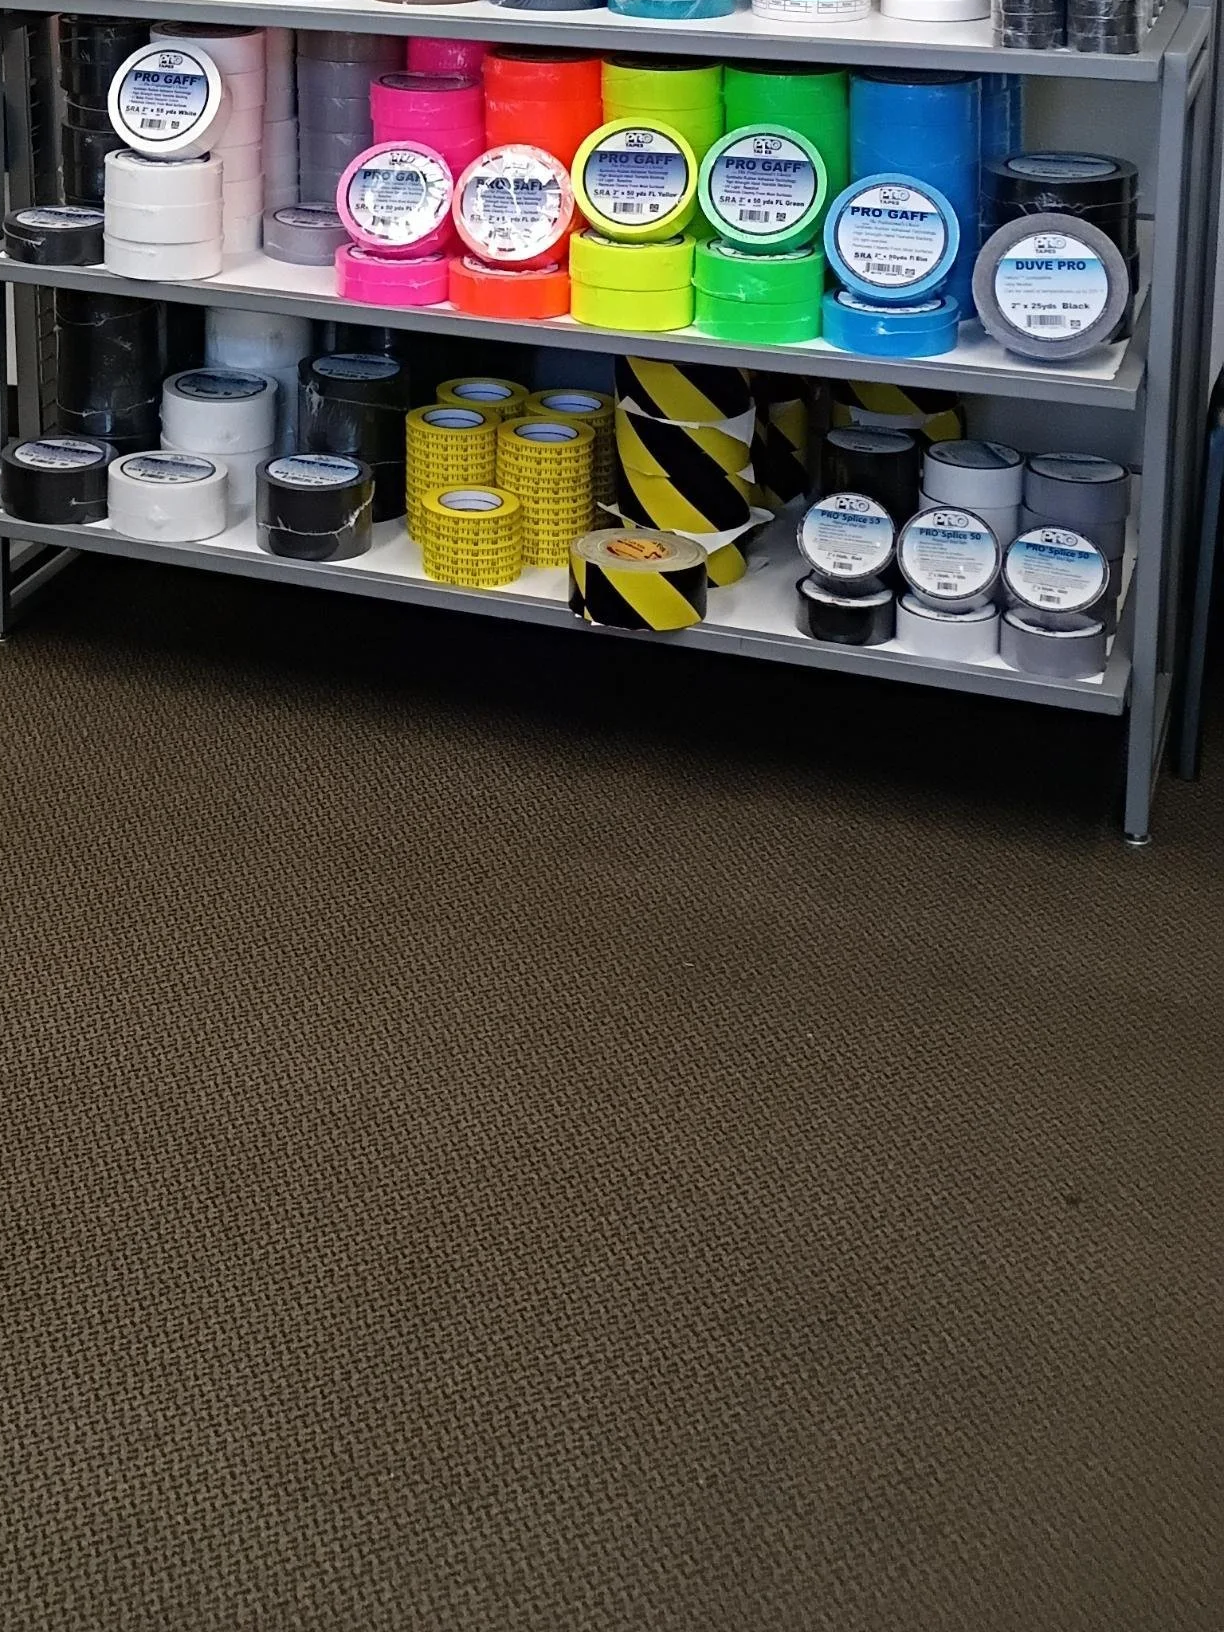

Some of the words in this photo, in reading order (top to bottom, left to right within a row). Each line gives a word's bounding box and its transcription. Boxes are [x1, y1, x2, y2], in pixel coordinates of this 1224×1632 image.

[134, 72, 161, 83] PRO
[164, 74, 197, 86] GAFF
[625, 132, 654, 144] PRO
[753, 138, 782, 151] PRO
[598, 153, 629, 164] PRO
[634, 154, 673, 165] GAFF
[725, 159, 756, 170] PRO
[761, 161, 802, 172] GAFF
[363, 170, 391, 181] PRO
[594, 189, 611, 197] SRA
[658, 191, 678, 199] Yellow
[719, 195, 736, 203] SRA
[879, 188, 911, 202] PRO
[850, 206, 883, 217] PRO
[887, 209, 928, 222] GAFF
[1033, 236, 1067, 250] PRO
[1015, 260, 1054, 271] DUVE
[1057, 260, 1087, 271] PRO
[1031, 302, 1057, 310] 25yds
[1061, 302, 1090, 310] Black
[834, 496, 870, 513] PRO
[820, 511, 840, 520] PRO
[842, 512, 867, 525] Splice
[932, 512, 970, 529] PRO
[919, 528, 940, 537] PRO
[941, 529, 968, 539] Splice
[969, 532, 982, 540] 50
[1040, 529, 1079, 547] PRO
[1025, 543, 1046, 552] PRO
[1047, 545, 1076, 558] Splice
